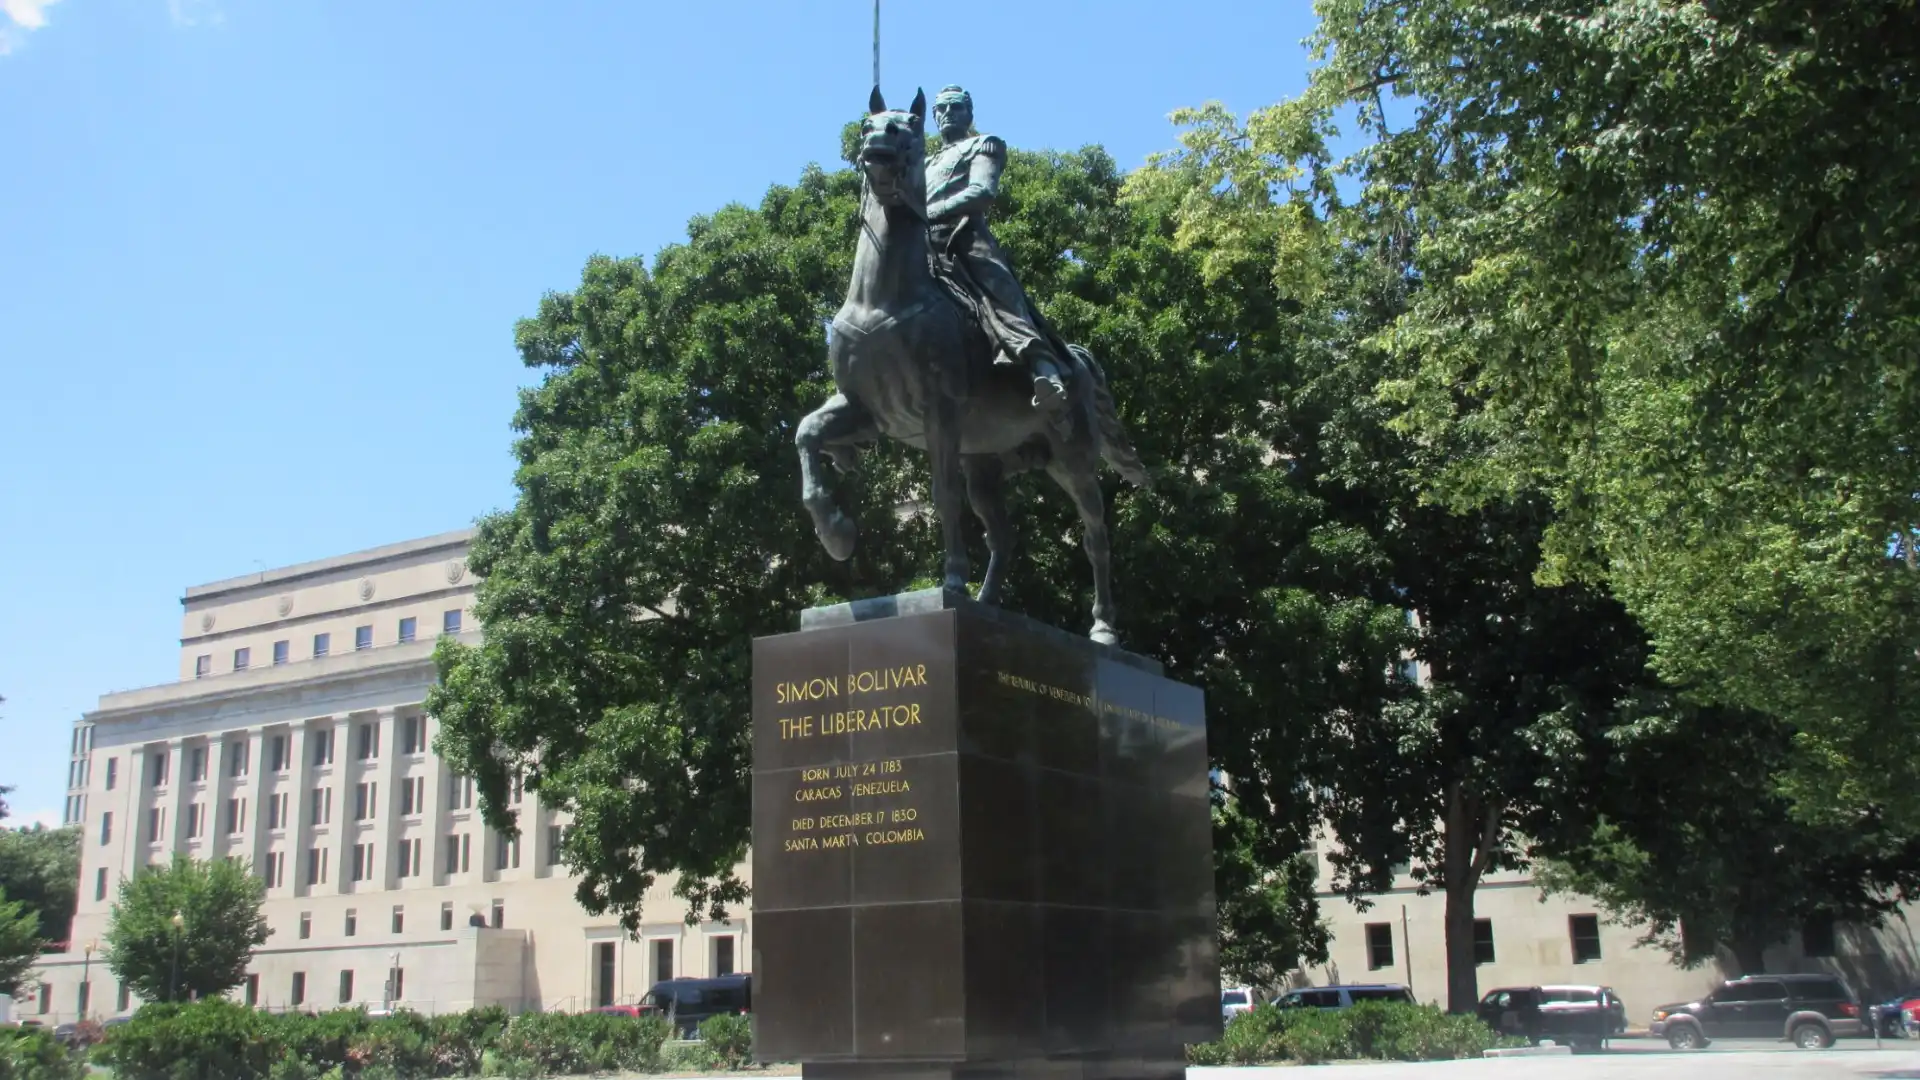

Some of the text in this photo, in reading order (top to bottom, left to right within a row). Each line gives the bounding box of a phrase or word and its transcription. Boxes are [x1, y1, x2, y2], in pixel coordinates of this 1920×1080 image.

[777, 664, 928, 704] SIMON BOLIVAR
[778, 703, 922, 740] THE LIBERATOR
[802, 759, 902, 782] BORN JULY 24 1783
[795, 780, 910, 802] CARACAS VENEZUELA
[792, 808, 917, 831] DIED DECEMBER 17 1830
[785, 828, 925, 852] SANTA MARTA COLOMBIA
